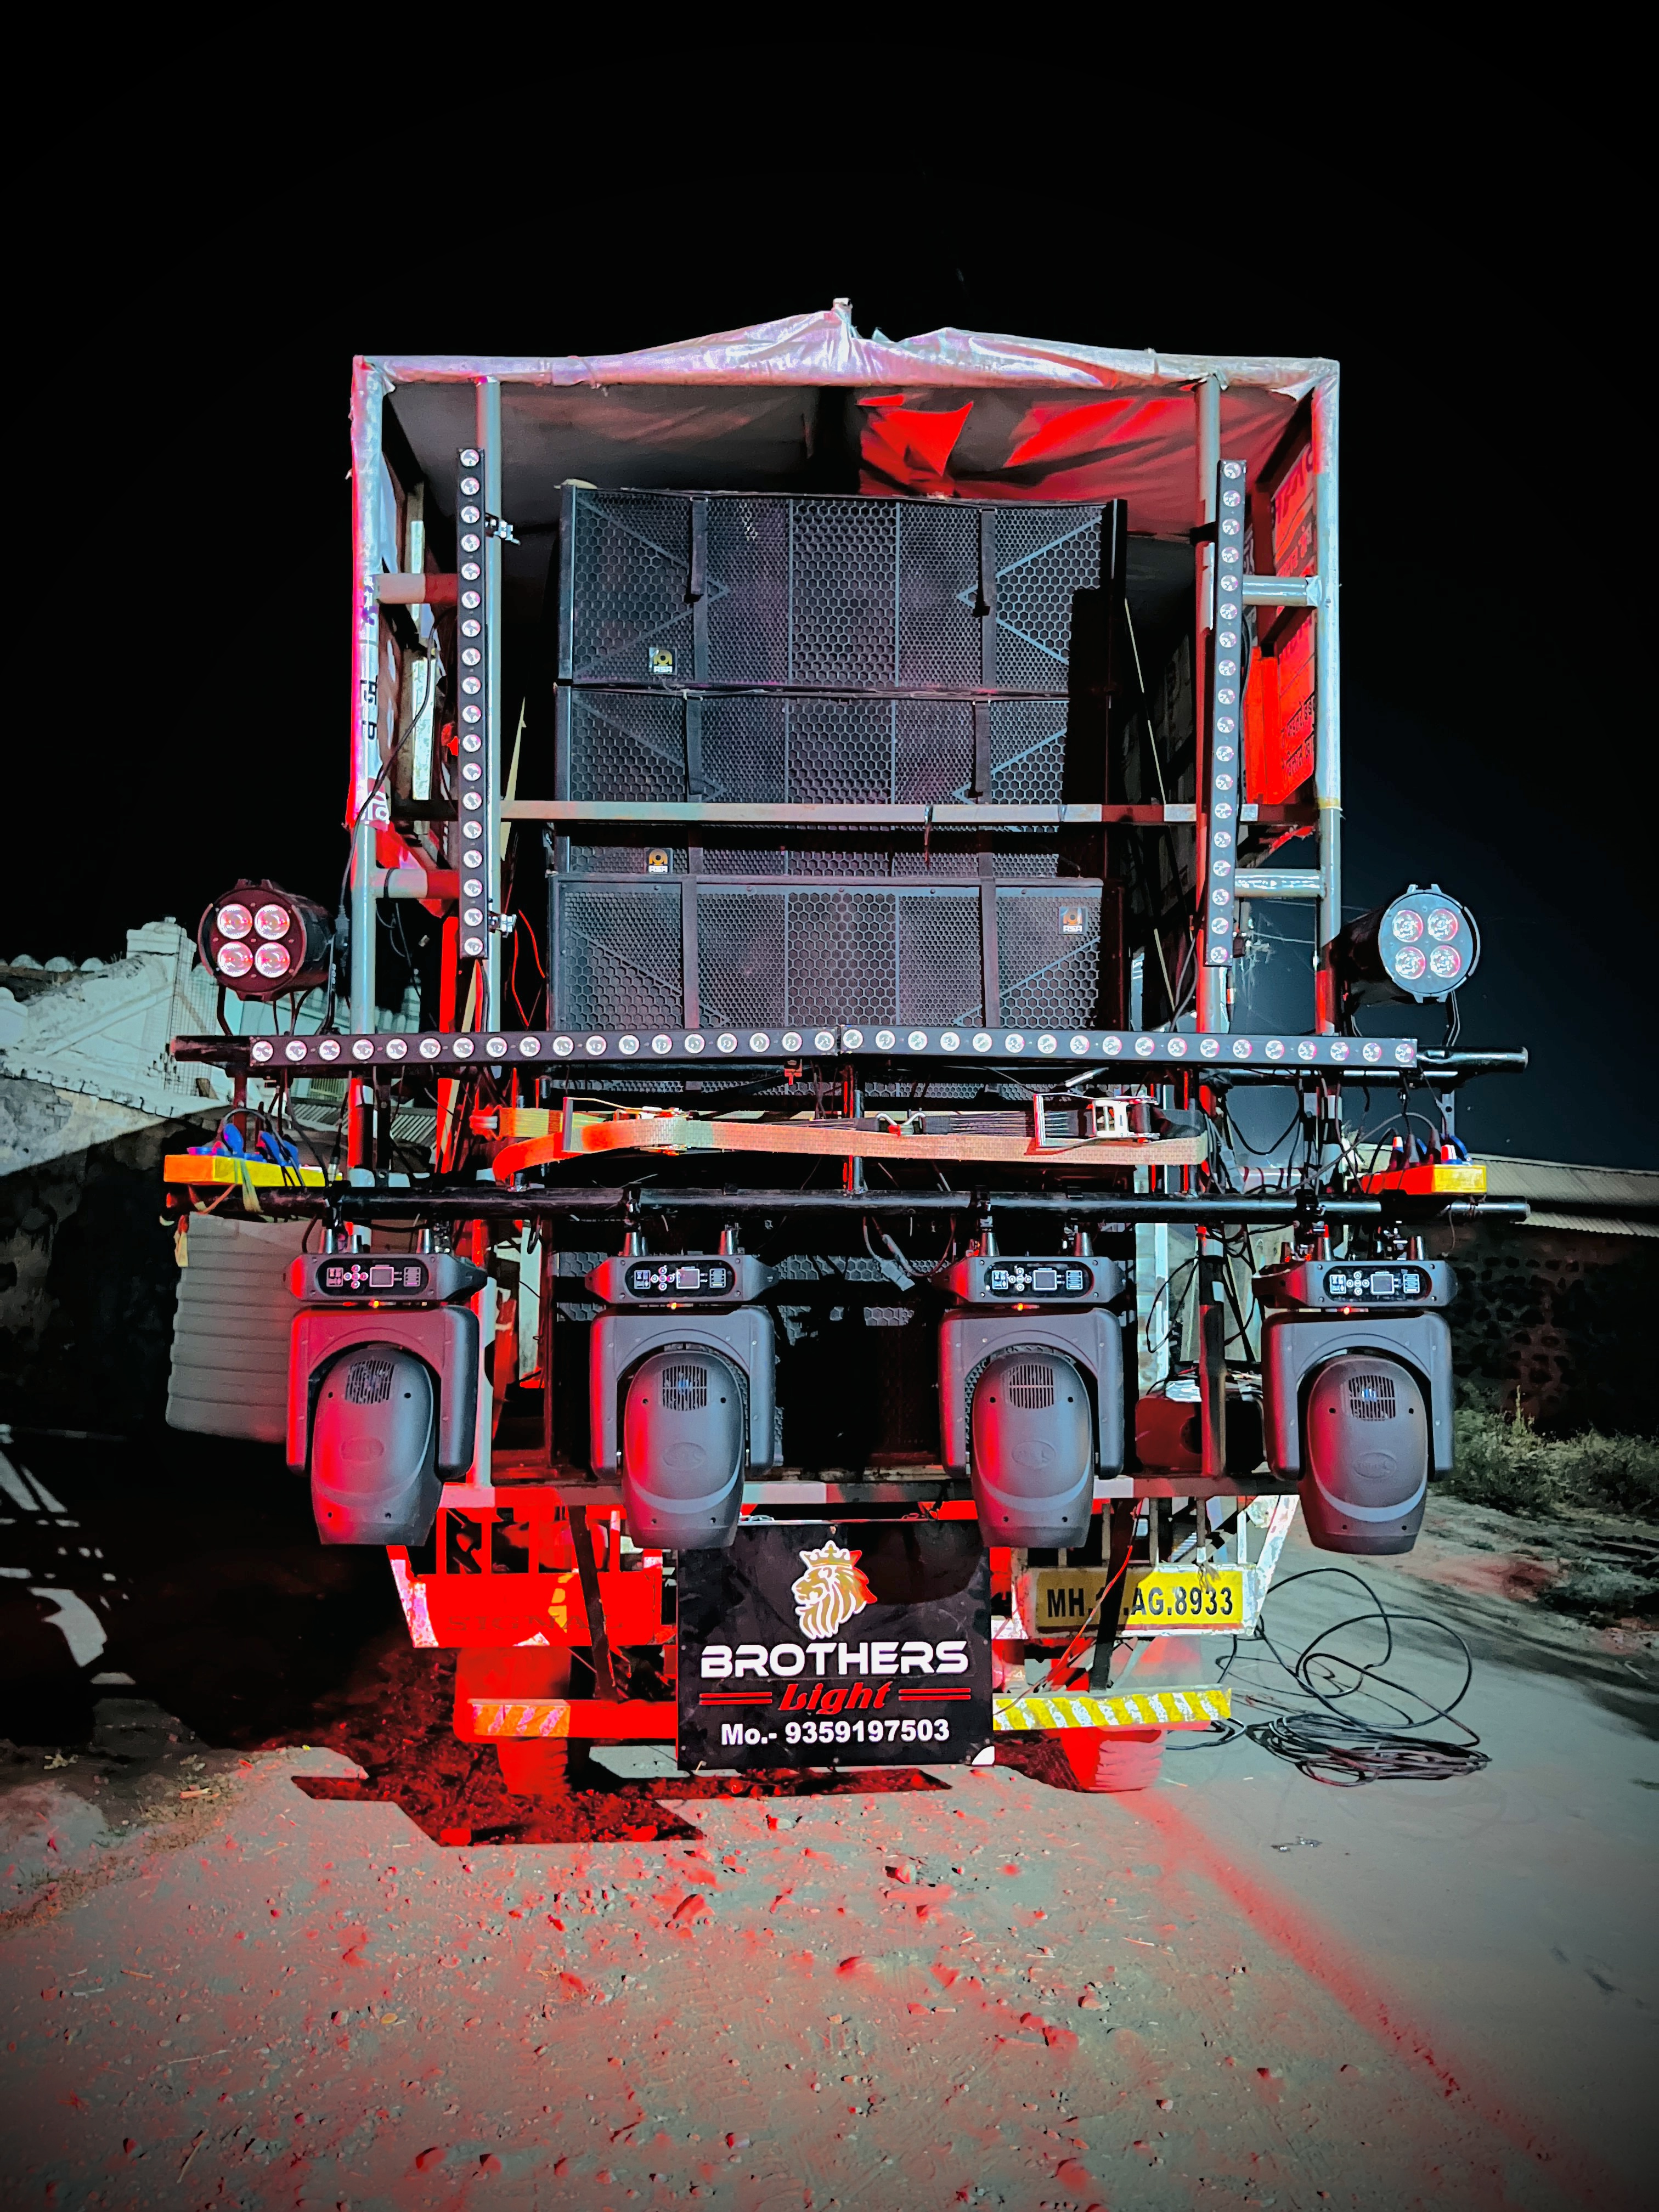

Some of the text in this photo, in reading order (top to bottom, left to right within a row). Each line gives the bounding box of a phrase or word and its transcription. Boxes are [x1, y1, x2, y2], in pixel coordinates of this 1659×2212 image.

[701, 1640, 969, 1678] BROTHERS
[777, 1680, 894, 1715] Light
[785, 1718, 950, 1744] 9359197503
